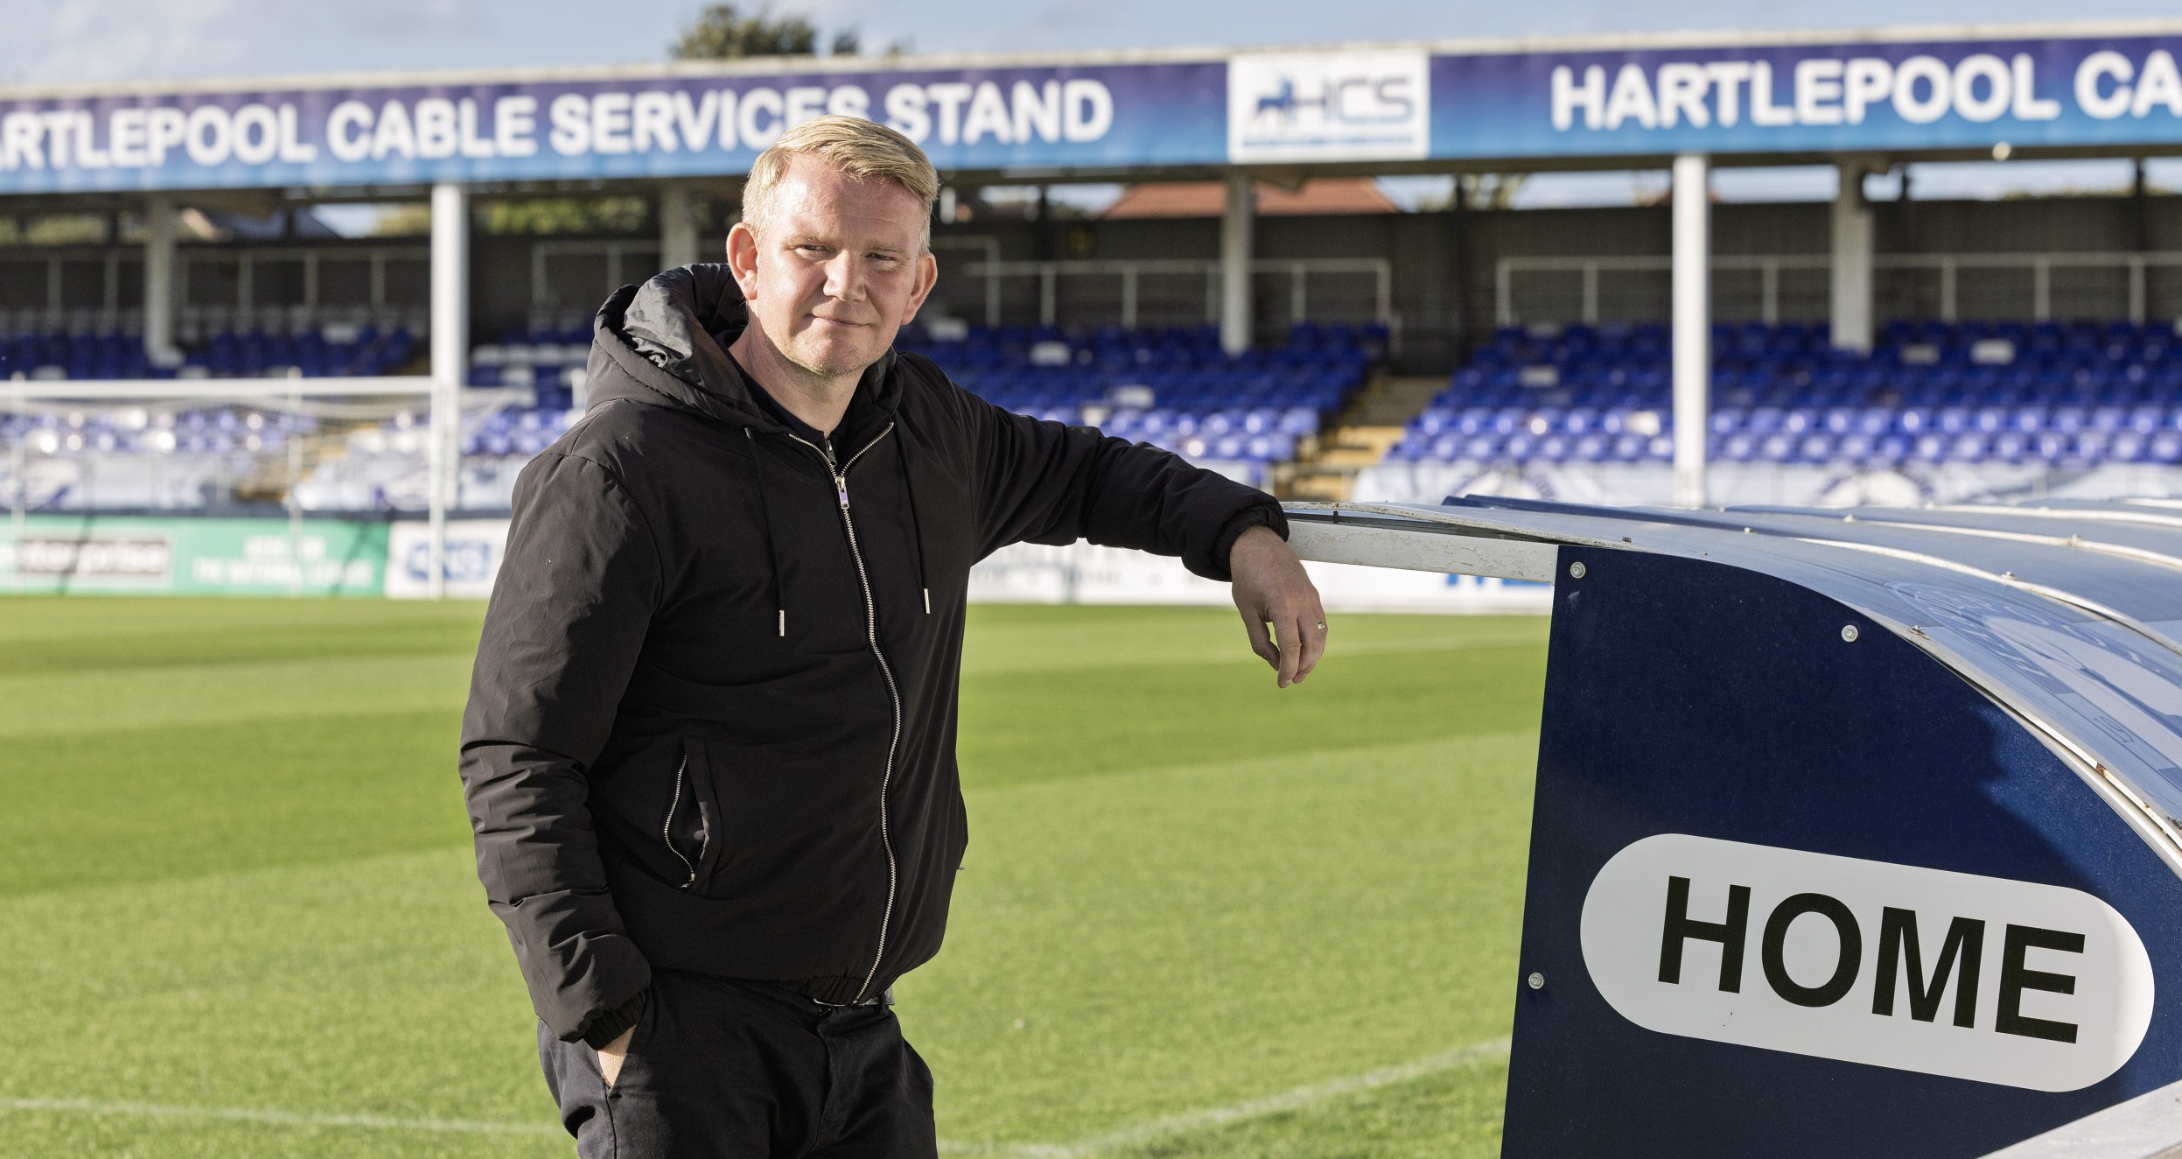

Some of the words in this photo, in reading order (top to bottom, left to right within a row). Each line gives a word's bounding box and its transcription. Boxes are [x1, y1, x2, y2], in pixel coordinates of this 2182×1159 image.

[0, 103, 317, 171] RTLEPOOL
[326, 95, 537, 163] CABLE
[548, 84, 871, 157] SERVICES
[884, 79, 1115, 146] STAND
[1551, 52, 2062, 131] HARTLEPOOL
[1658, 875, 2086, 1044] HOME
